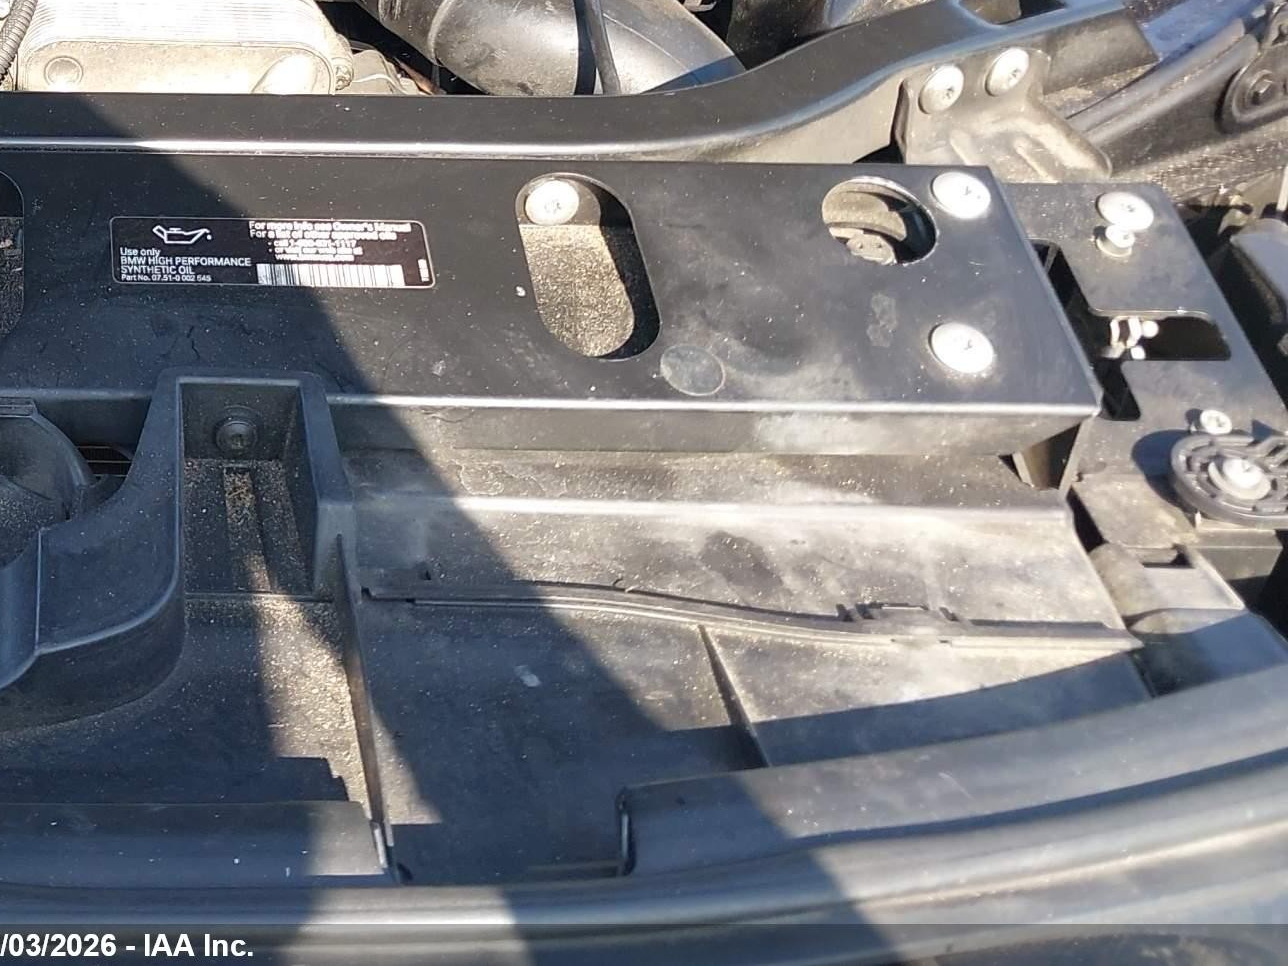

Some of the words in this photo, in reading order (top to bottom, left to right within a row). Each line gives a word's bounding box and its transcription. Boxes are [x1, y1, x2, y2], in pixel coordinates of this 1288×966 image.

[249, 221, 266, 230] For
[250, 229, 266, 238] For
[120, 247, 139, 256] Use
[140, 247, 161, 259] only
[120, 256, 146, 265] BMW
[148, 256, 173, 266] HIGH
[175, 257, 252, 267] PERFORMANCE
[121, 265, 177, 275] SYNTHETIC
[178, 266, 195, 275] OIL
